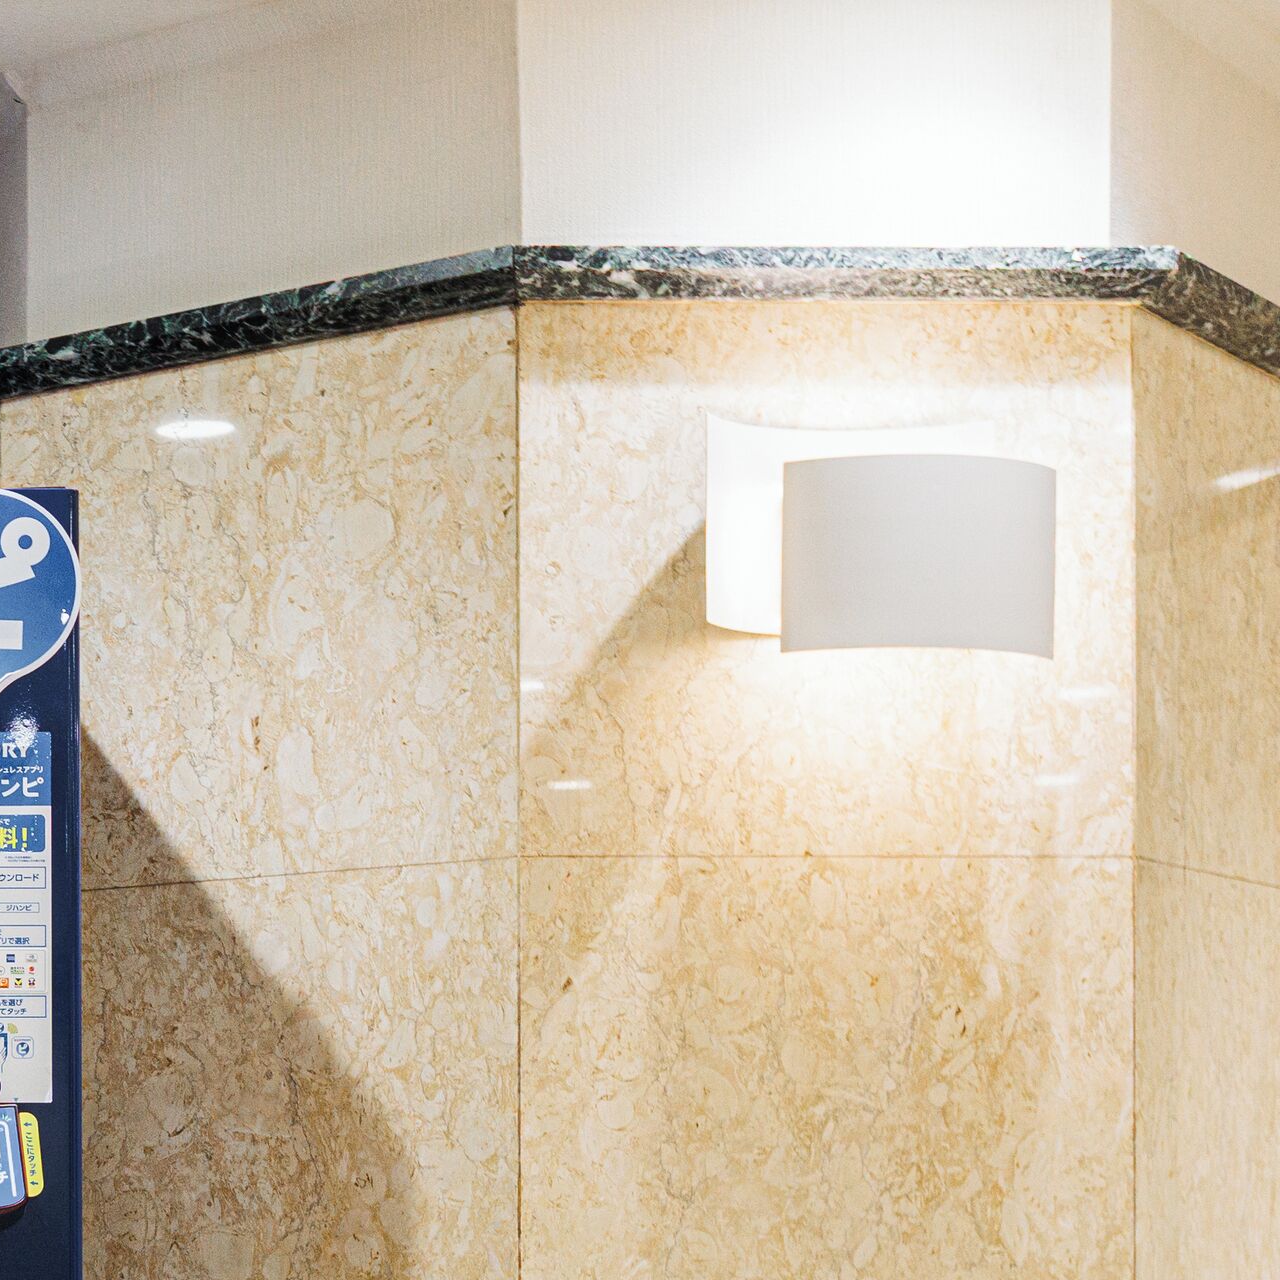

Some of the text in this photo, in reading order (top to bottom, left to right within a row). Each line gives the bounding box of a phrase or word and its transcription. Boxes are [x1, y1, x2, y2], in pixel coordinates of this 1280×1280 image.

[25, 1132, 37, 1176] ここにタッチ
